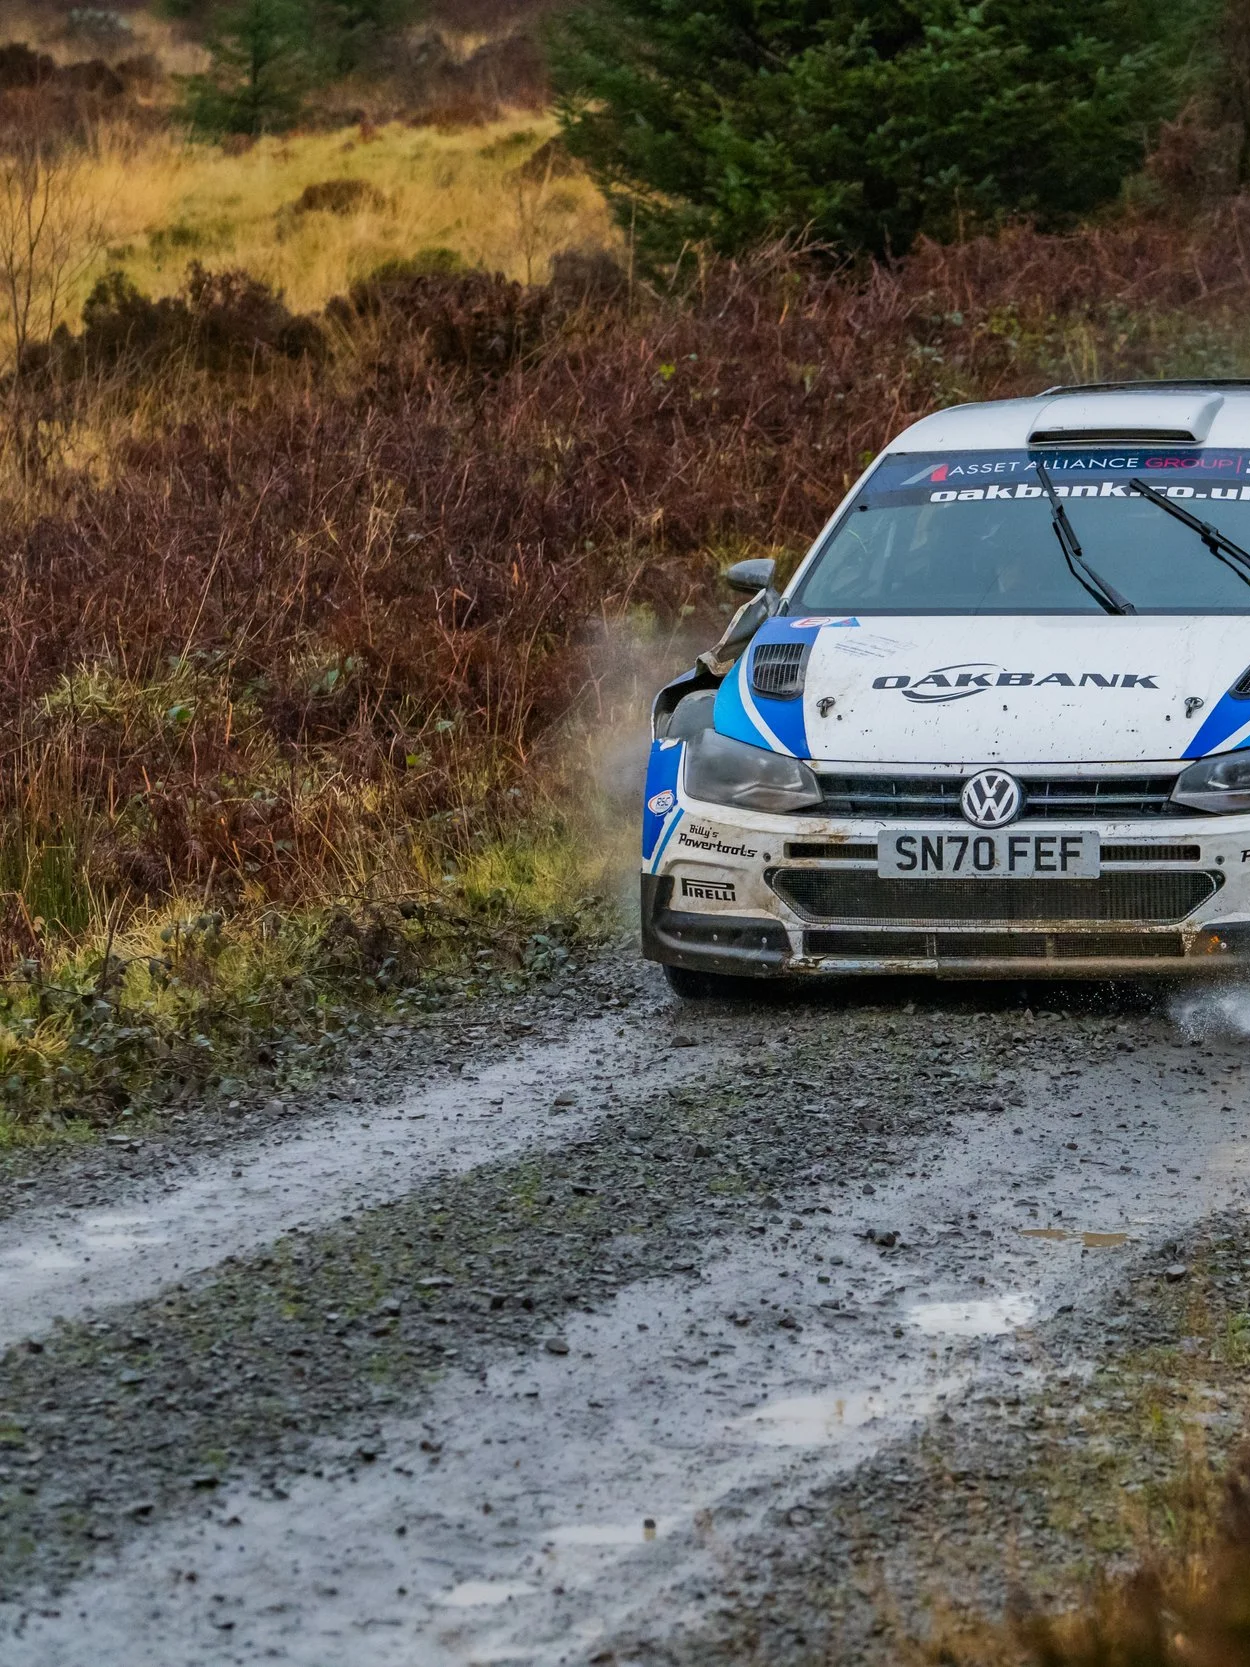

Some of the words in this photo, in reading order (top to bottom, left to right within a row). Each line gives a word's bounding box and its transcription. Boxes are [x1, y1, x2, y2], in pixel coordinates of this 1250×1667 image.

[948, 461, 1020, 477] ASSET
[1024, 457, 1139, 471] ALLIANCE
[1144, 457, 1234, 470] GROUP
[871, 672, 1160, 690] OAKBANK
[689, 824, 720, 839] Billy's
[678, 832, 758, 858] Powertools
[895, 835, 996, 871] SN70
[1008, 836, 1083, 871] FEF
[681, 878, 736, 902] PIRELLI
